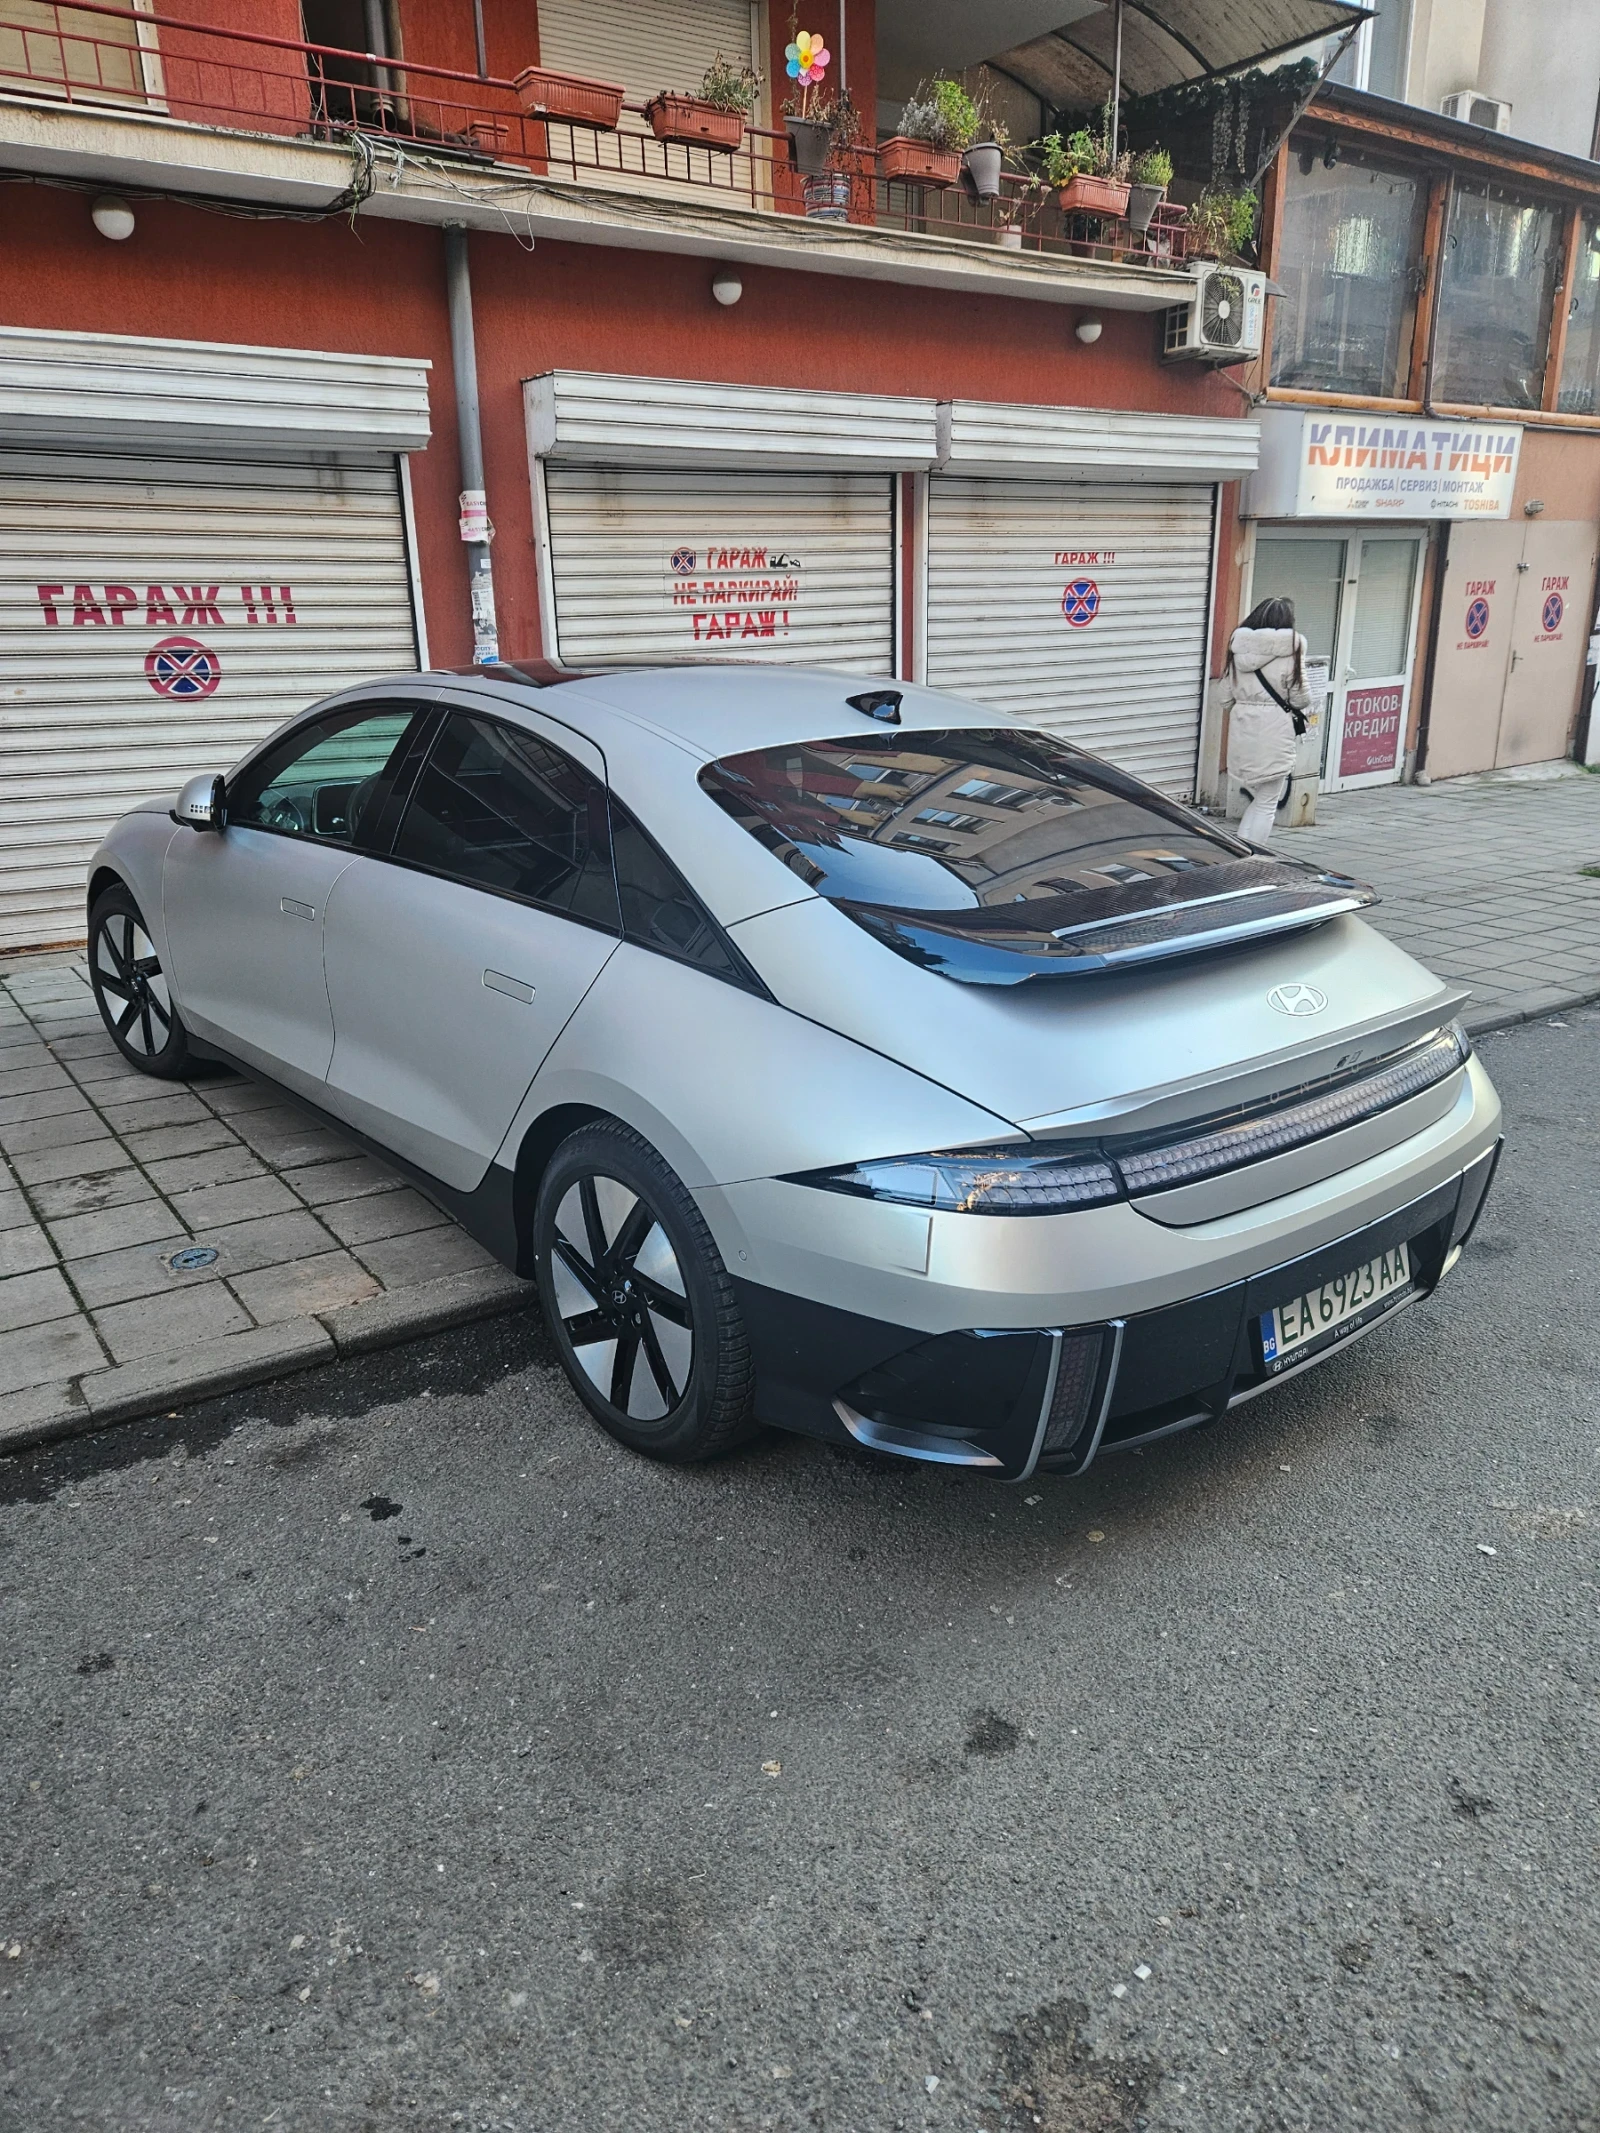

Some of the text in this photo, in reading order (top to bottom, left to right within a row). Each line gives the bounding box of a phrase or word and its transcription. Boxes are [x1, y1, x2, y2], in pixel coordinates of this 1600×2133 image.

[1308, 424, 1516, 480] КЛИМАТИЦИ
[1336, 477, 1484, 493] ПРОДАЖБА СЕРВИЗ МОНТАЖ
[1375, 499, 1405, 508] SHARP
[1463, 500, 1500, 510] TOSHIBA
[707, 547, 769, 570] ГАРАЖ
[1054, 552, 1116, 565] ГАРАЖ !!!
[673, 573, 799, 605] НЕ ПАРКИРАЙ!
[1465, 580, 1497, 596] ГАРАЖ
[1541, 576, 1570, 591] ГАРАЖ
[37, 585, 297, 625] ГАРАЖ !!!
[692, 611, 776, 641] ГАРАЖ
[1344, 716, 1398, 740] КРЕДИТ
[1277, 1246, 1406, 1346] EA 6923 AA
[1262, 1337, 1276, 1354] BG
[1283, 1347, 1309, 1366] HYUNDAI
[1334, 1329, 1340, 1339] A
[1339, 1325, 1350, 1336] way
[1349, 1319, 1355, 1330] of
[1355, 1316, 1363, 1327] life
